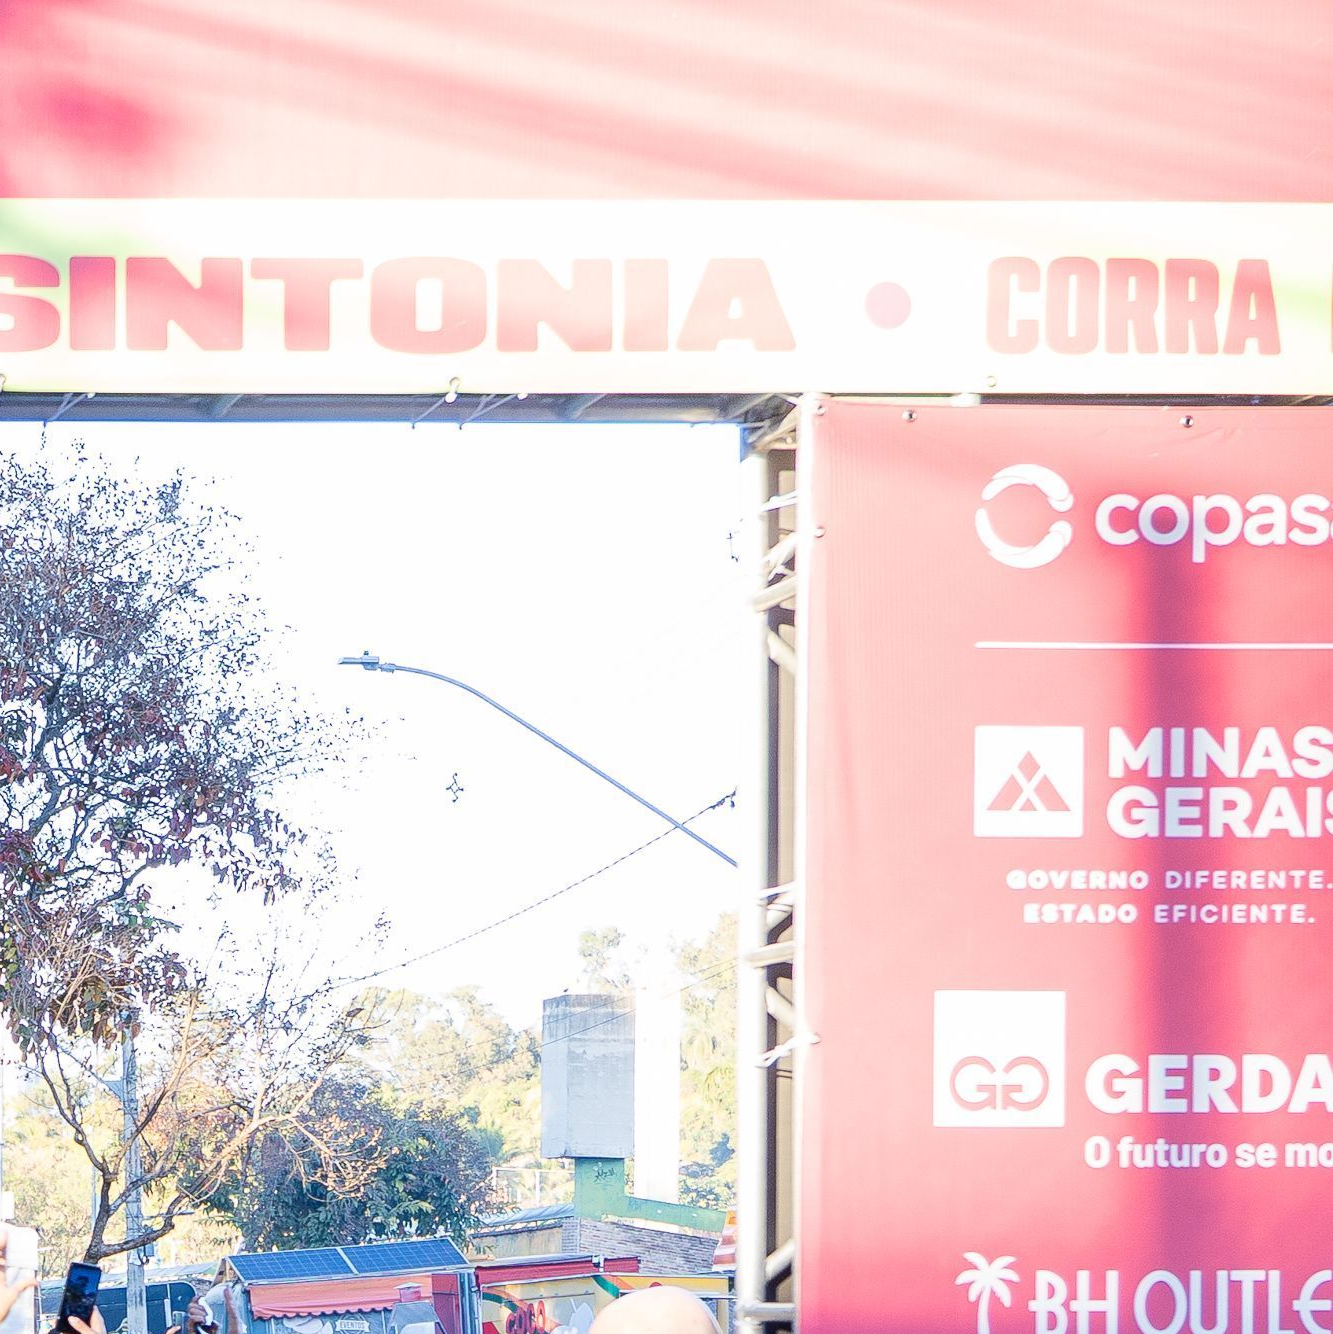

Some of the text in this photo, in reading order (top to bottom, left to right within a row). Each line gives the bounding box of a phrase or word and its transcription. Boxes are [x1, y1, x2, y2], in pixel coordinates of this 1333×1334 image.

[985, 256, 1282, 355] CORRA
[1107, 726, 1333, 779] MINAS
[1105, 785, 1333, 838] GERAI
[1005, 868, 1333, 890] GOVERNO DIFERENTE.
[1022, 903, 1317, 924] ESTADO EFICIENTE.
[1084, 1053, 1333, 1115] GERDA
[1116, 1136, 1228, 1168] futuro
[1235, 1142, 1278, 1168] se
